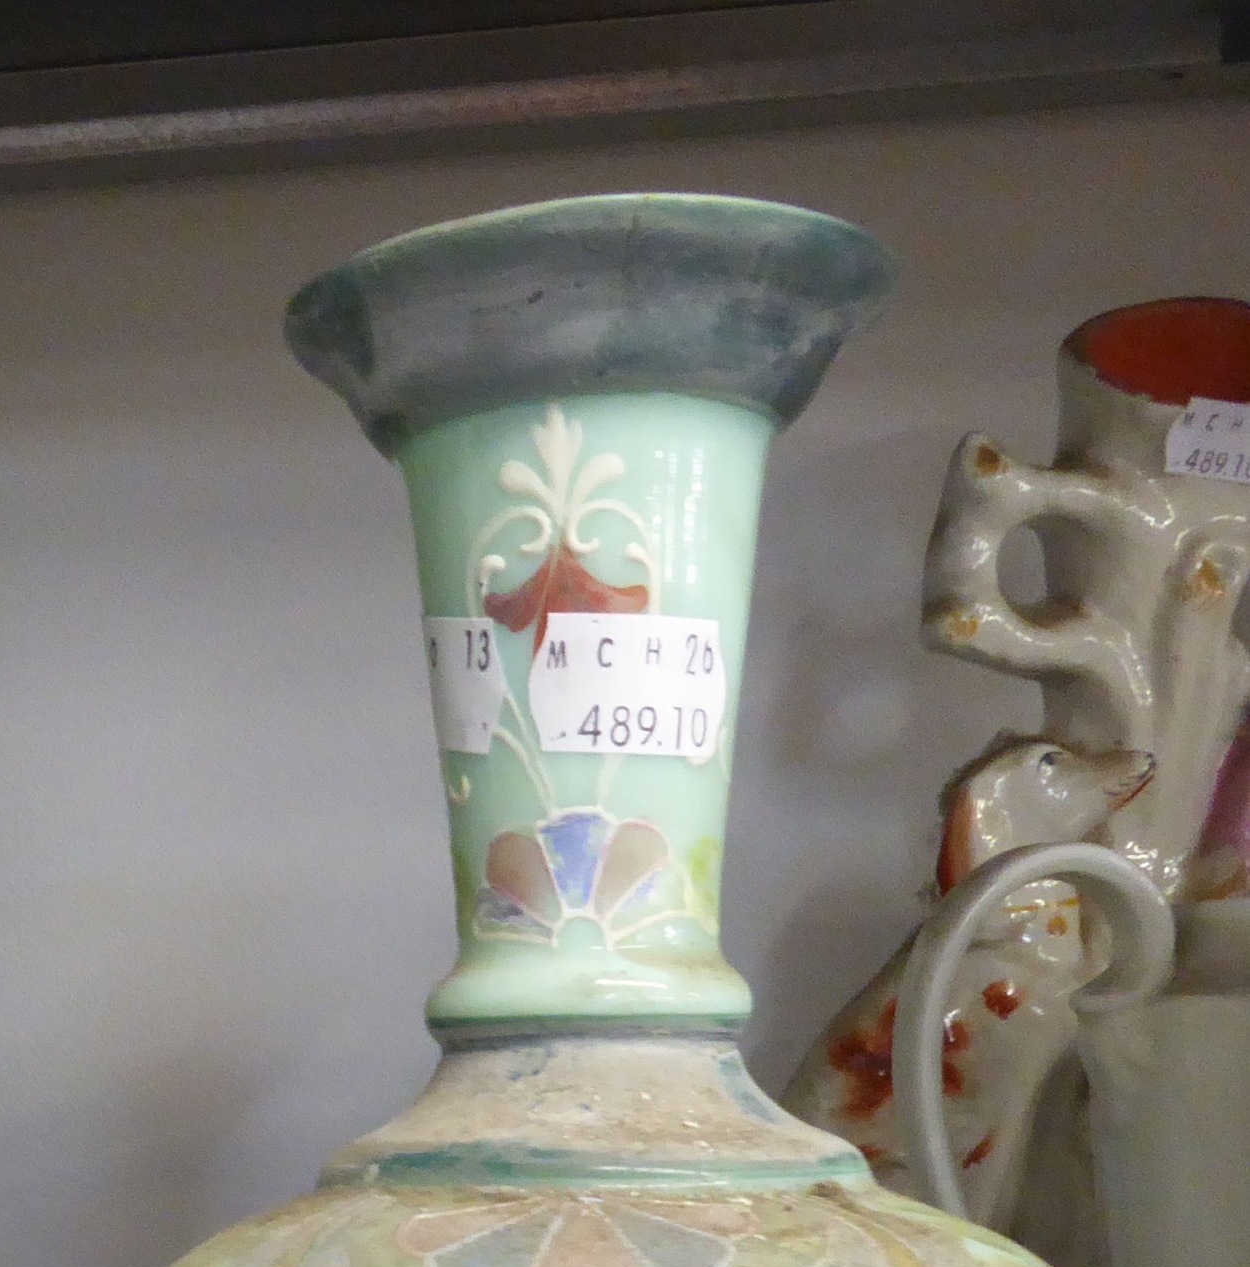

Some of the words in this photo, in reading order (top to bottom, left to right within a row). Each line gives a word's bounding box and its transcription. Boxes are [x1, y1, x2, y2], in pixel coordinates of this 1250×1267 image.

[466, 630, 490, 671] 13
[547, 640, 568, 669] M
[597, 638, 614, 668] C
[645, 637, 661, 666] H
[686, 634, 714, 674] 26
